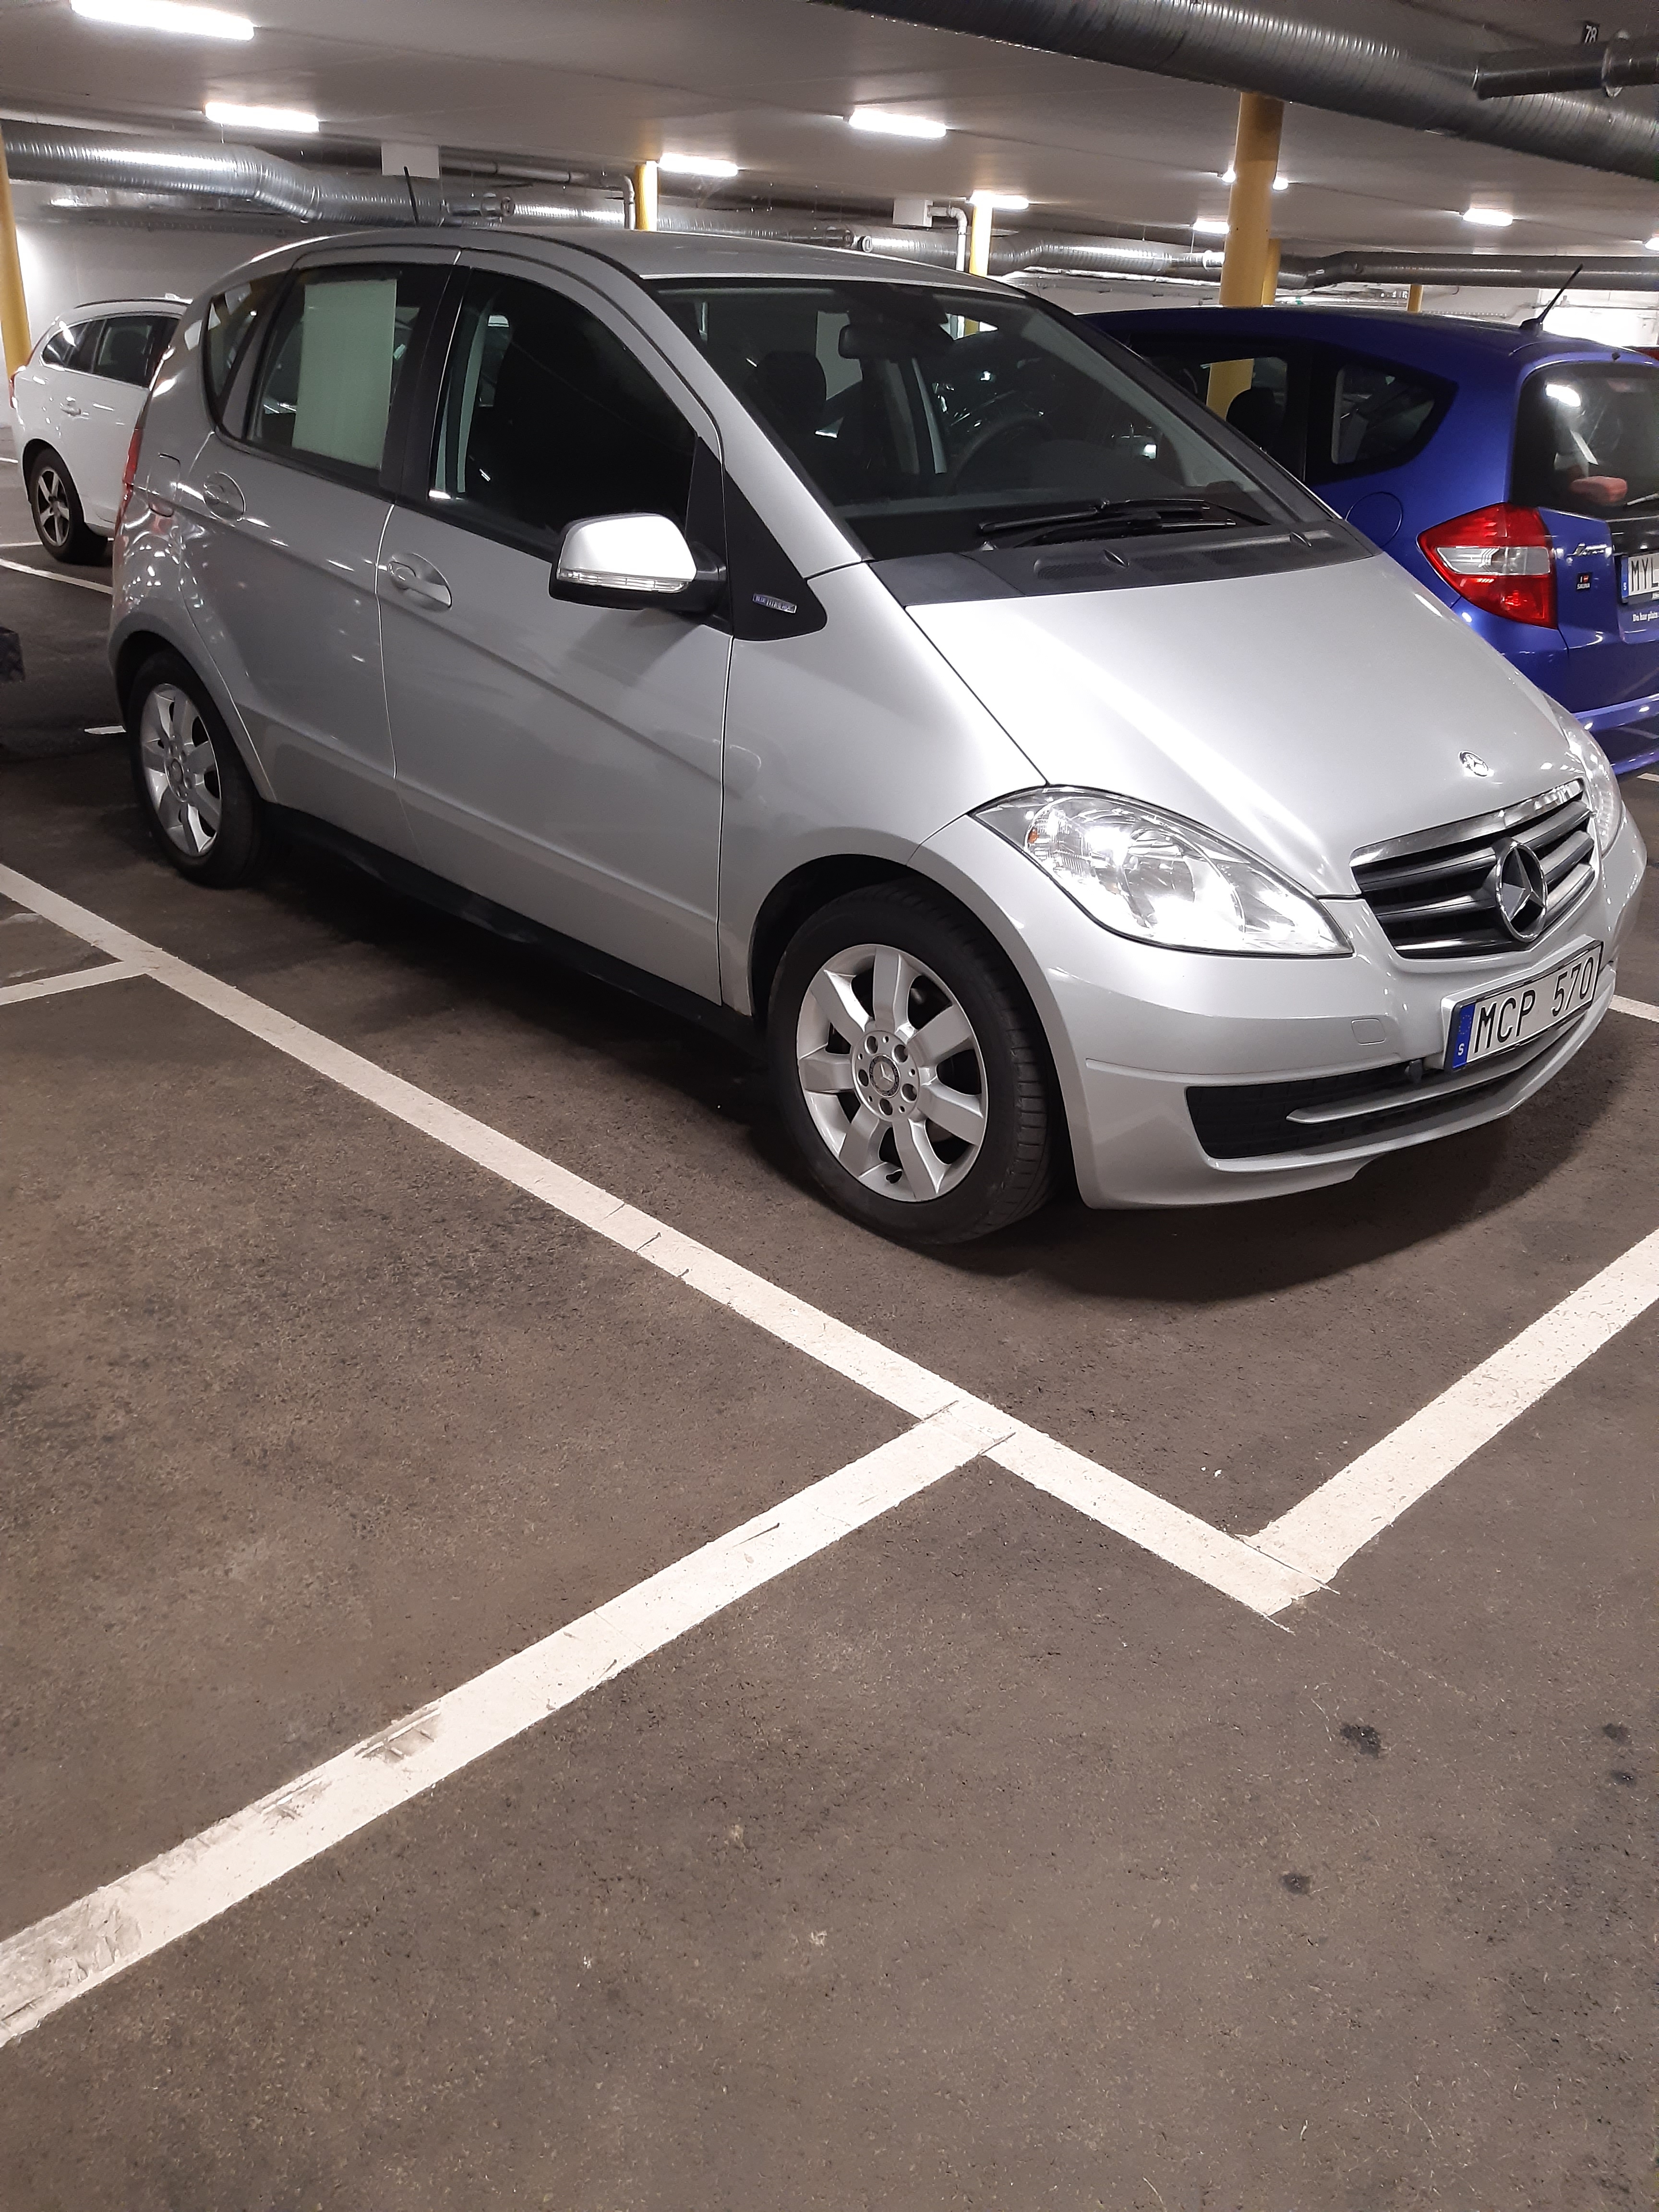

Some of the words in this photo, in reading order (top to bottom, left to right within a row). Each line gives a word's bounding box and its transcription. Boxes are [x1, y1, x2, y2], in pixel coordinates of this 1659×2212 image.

[1623, 582, 1627, 590] S
[1631, 557, 1659, 592] MYL
[1474, 989, 1536, 1054] MCP
[1551, 957, 1594, 1017] 570
[1457, 1043, 1465, 1056] S
